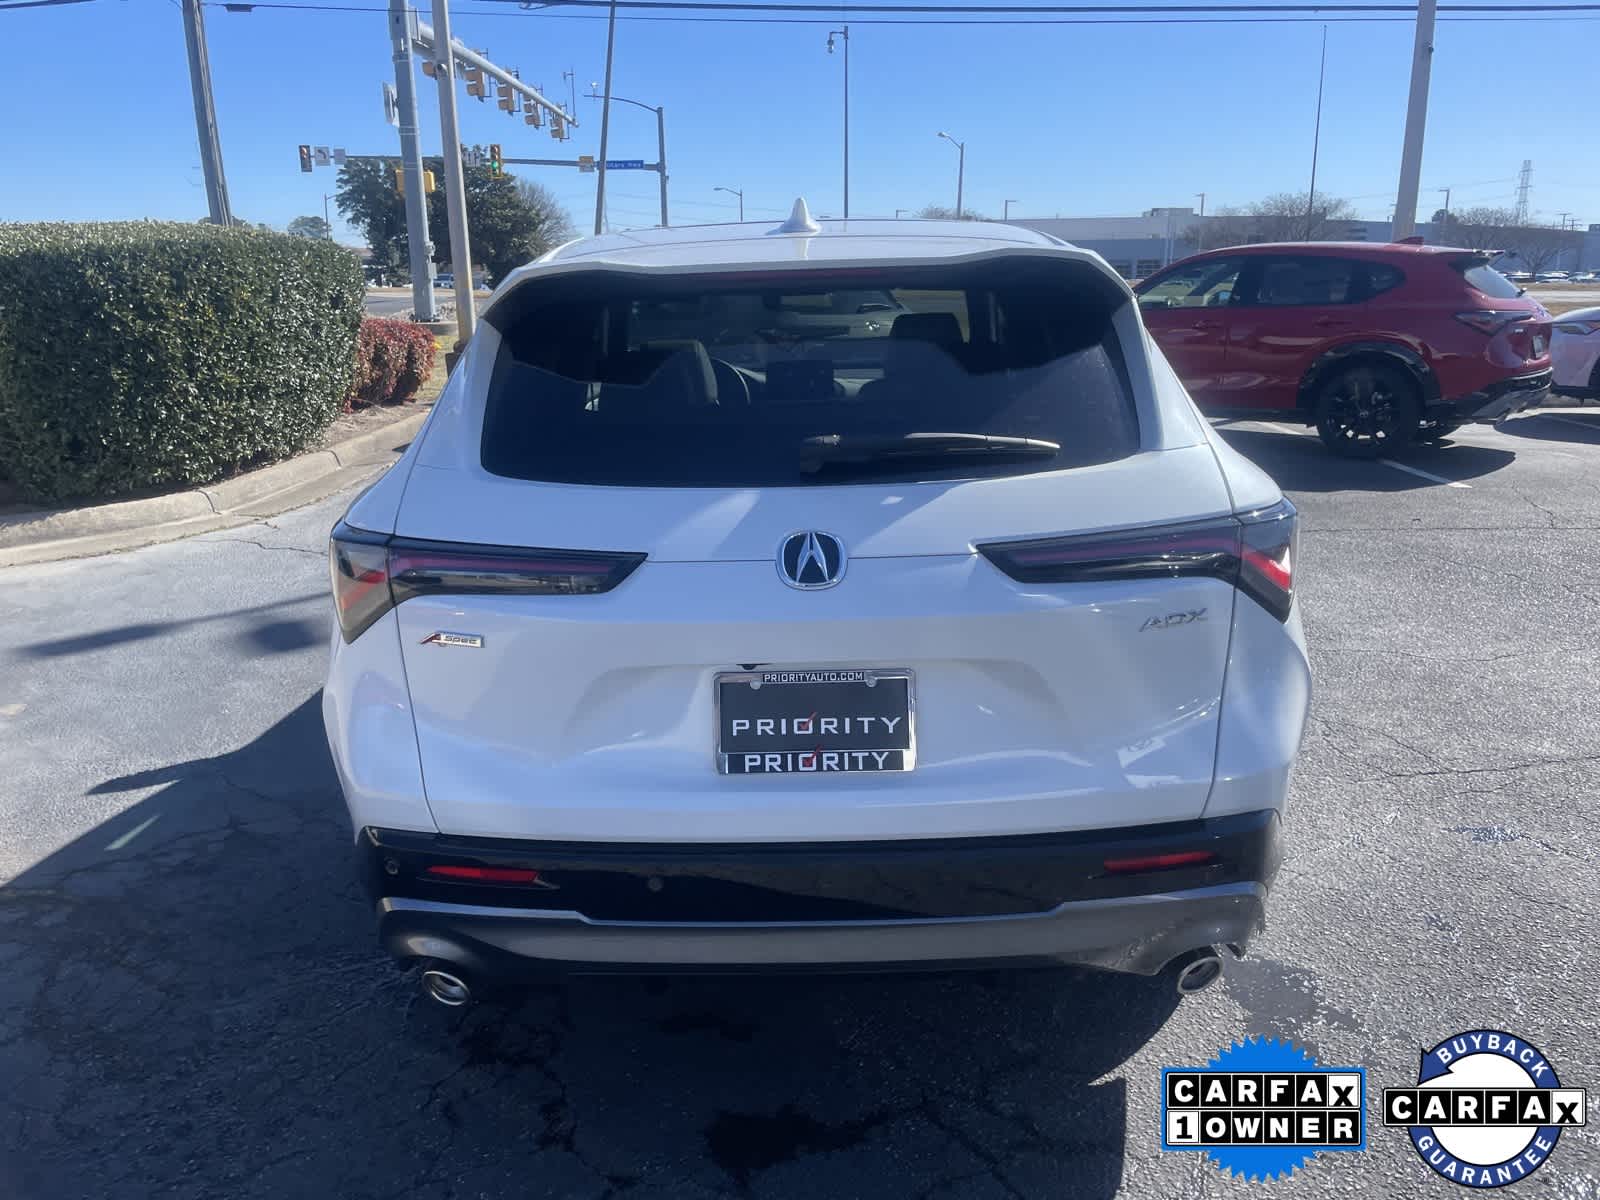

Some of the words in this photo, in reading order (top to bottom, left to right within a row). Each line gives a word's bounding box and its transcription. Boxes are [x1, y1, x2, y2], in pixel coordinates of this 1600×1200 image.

[764, 672, 864, 682] PRIORITYAUTO.COM
[732, 716, 901, 736] PRIORITY
[744, 751, 889, 772] PRIORITY
